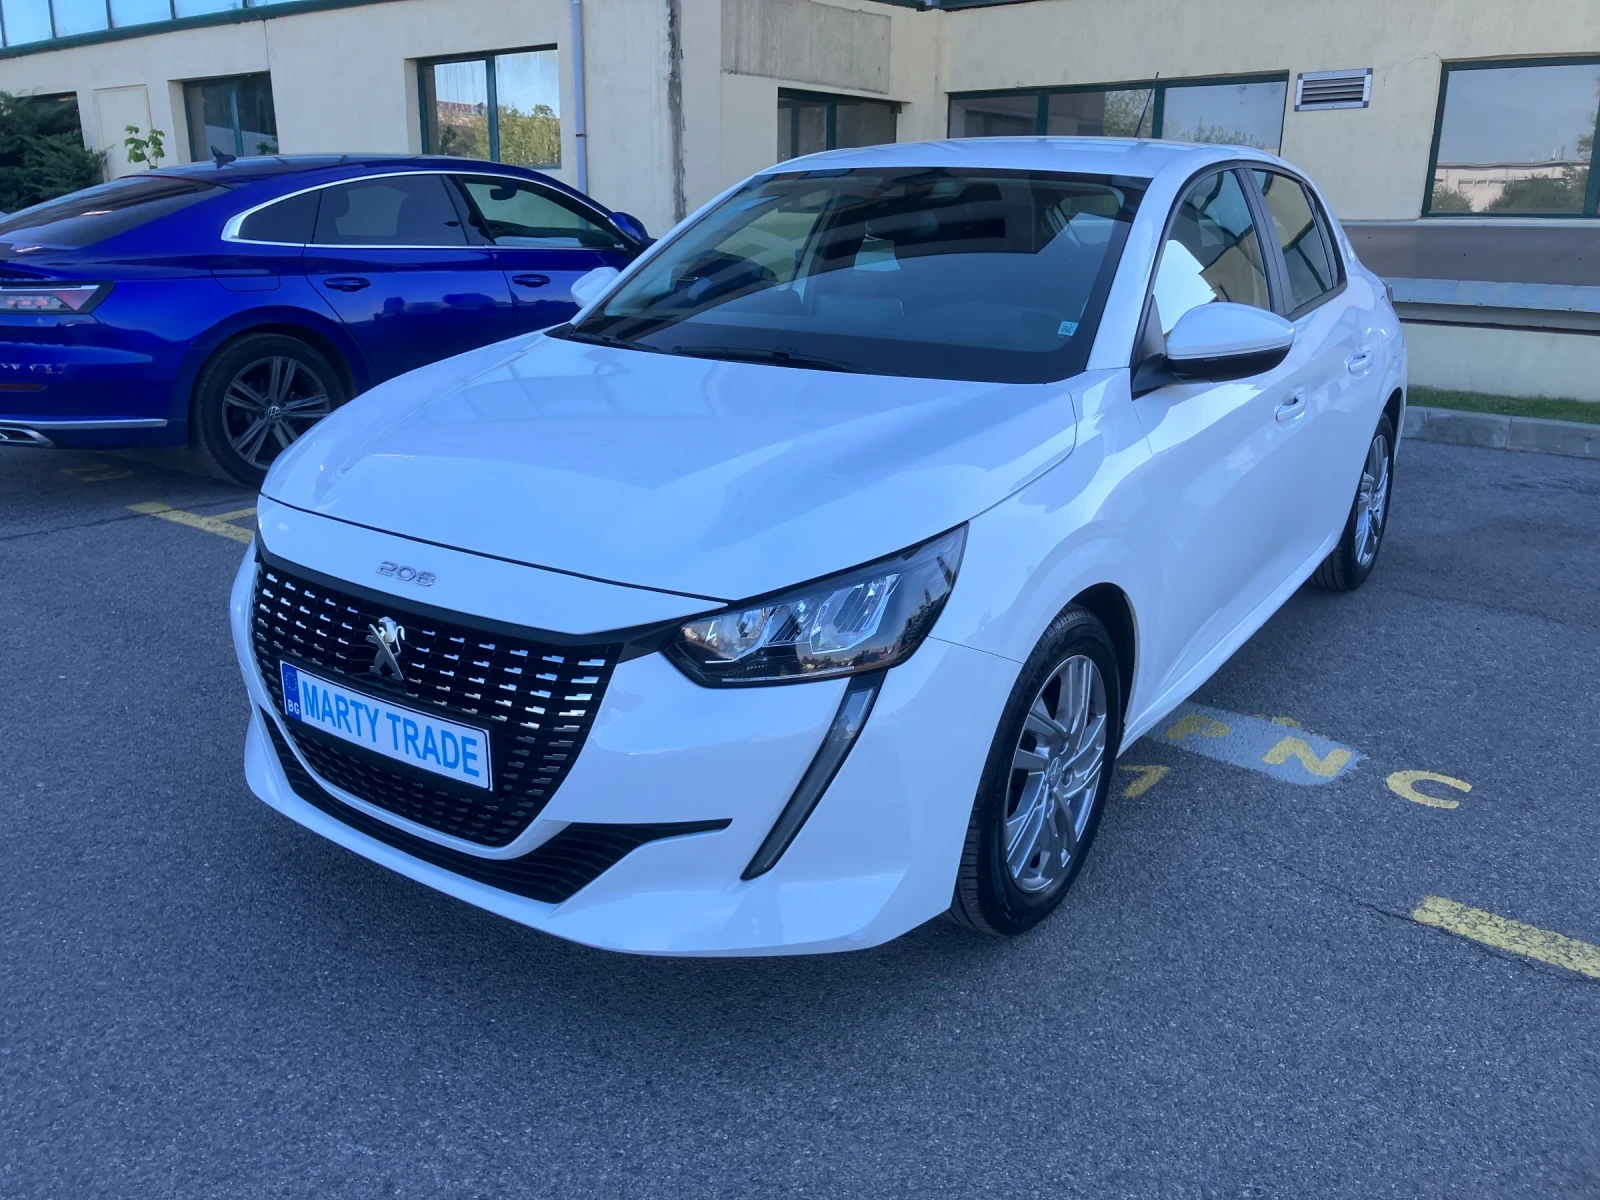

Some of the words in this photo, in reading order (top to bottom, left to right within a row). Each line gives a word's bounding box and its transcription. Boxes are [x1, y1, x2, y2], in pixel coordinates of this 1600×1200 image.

[376, 560, 437, 587] 208
[287, 698, 300, 715] BG
[302, 680, 380, 743] MARTY
[386, 711, 480, 778] TRADE
